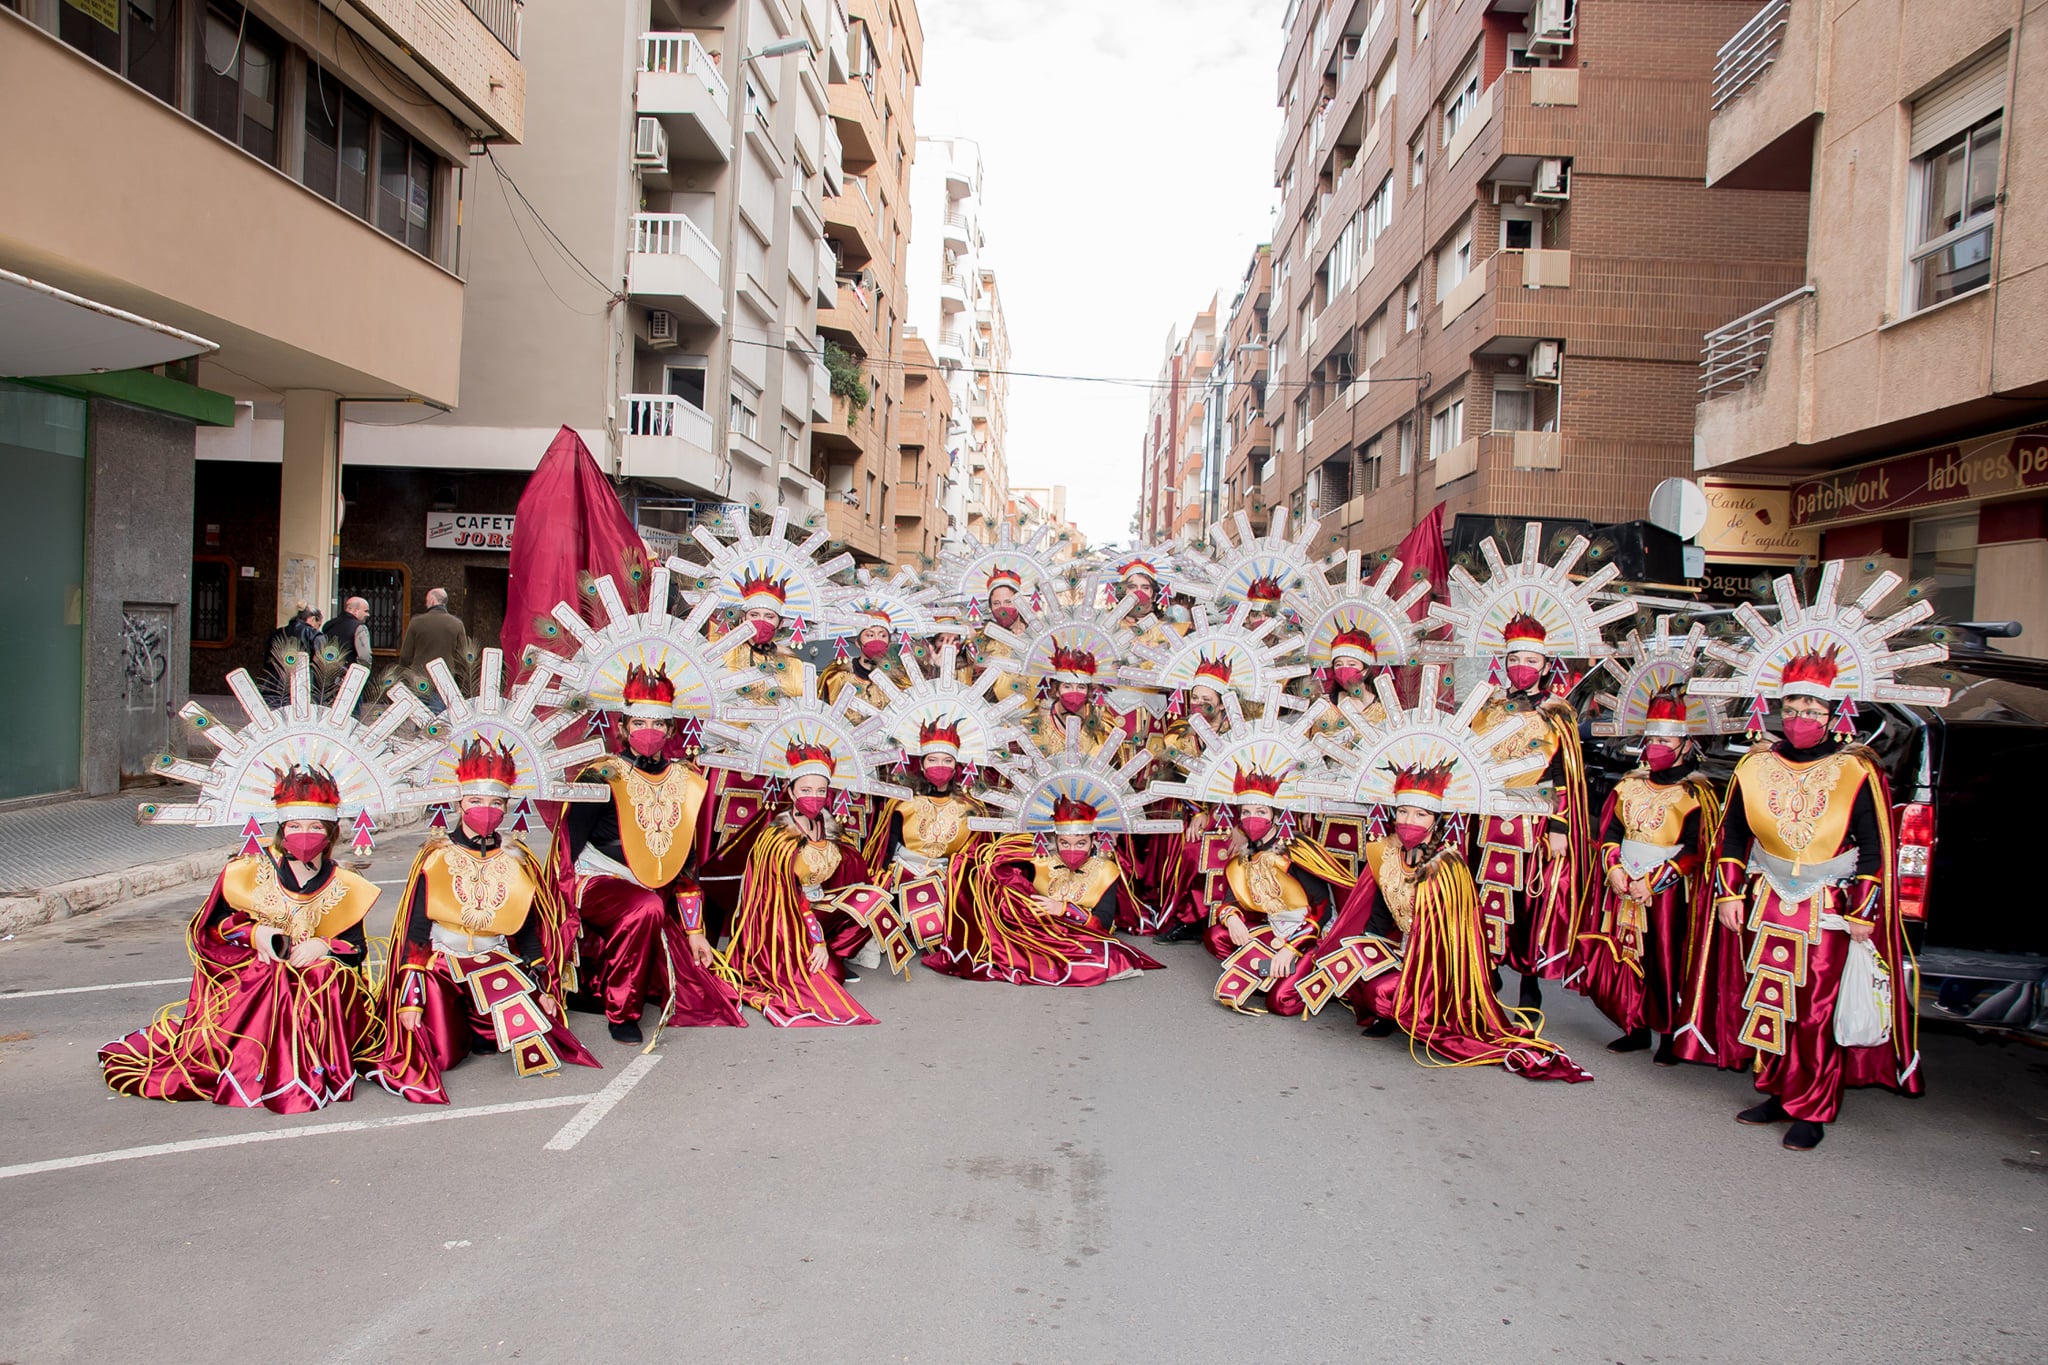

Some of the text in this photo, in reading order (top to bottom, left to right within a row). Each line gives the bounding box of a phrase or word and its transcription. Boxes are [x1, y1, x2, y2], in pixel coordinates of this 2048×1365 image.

[1796, 467, 1890, 524] patchwork
[1927, 454, 2009, 491] labores
[455, 516, 514, 530] CAFET
[1726, 514, 1745, 529] de
